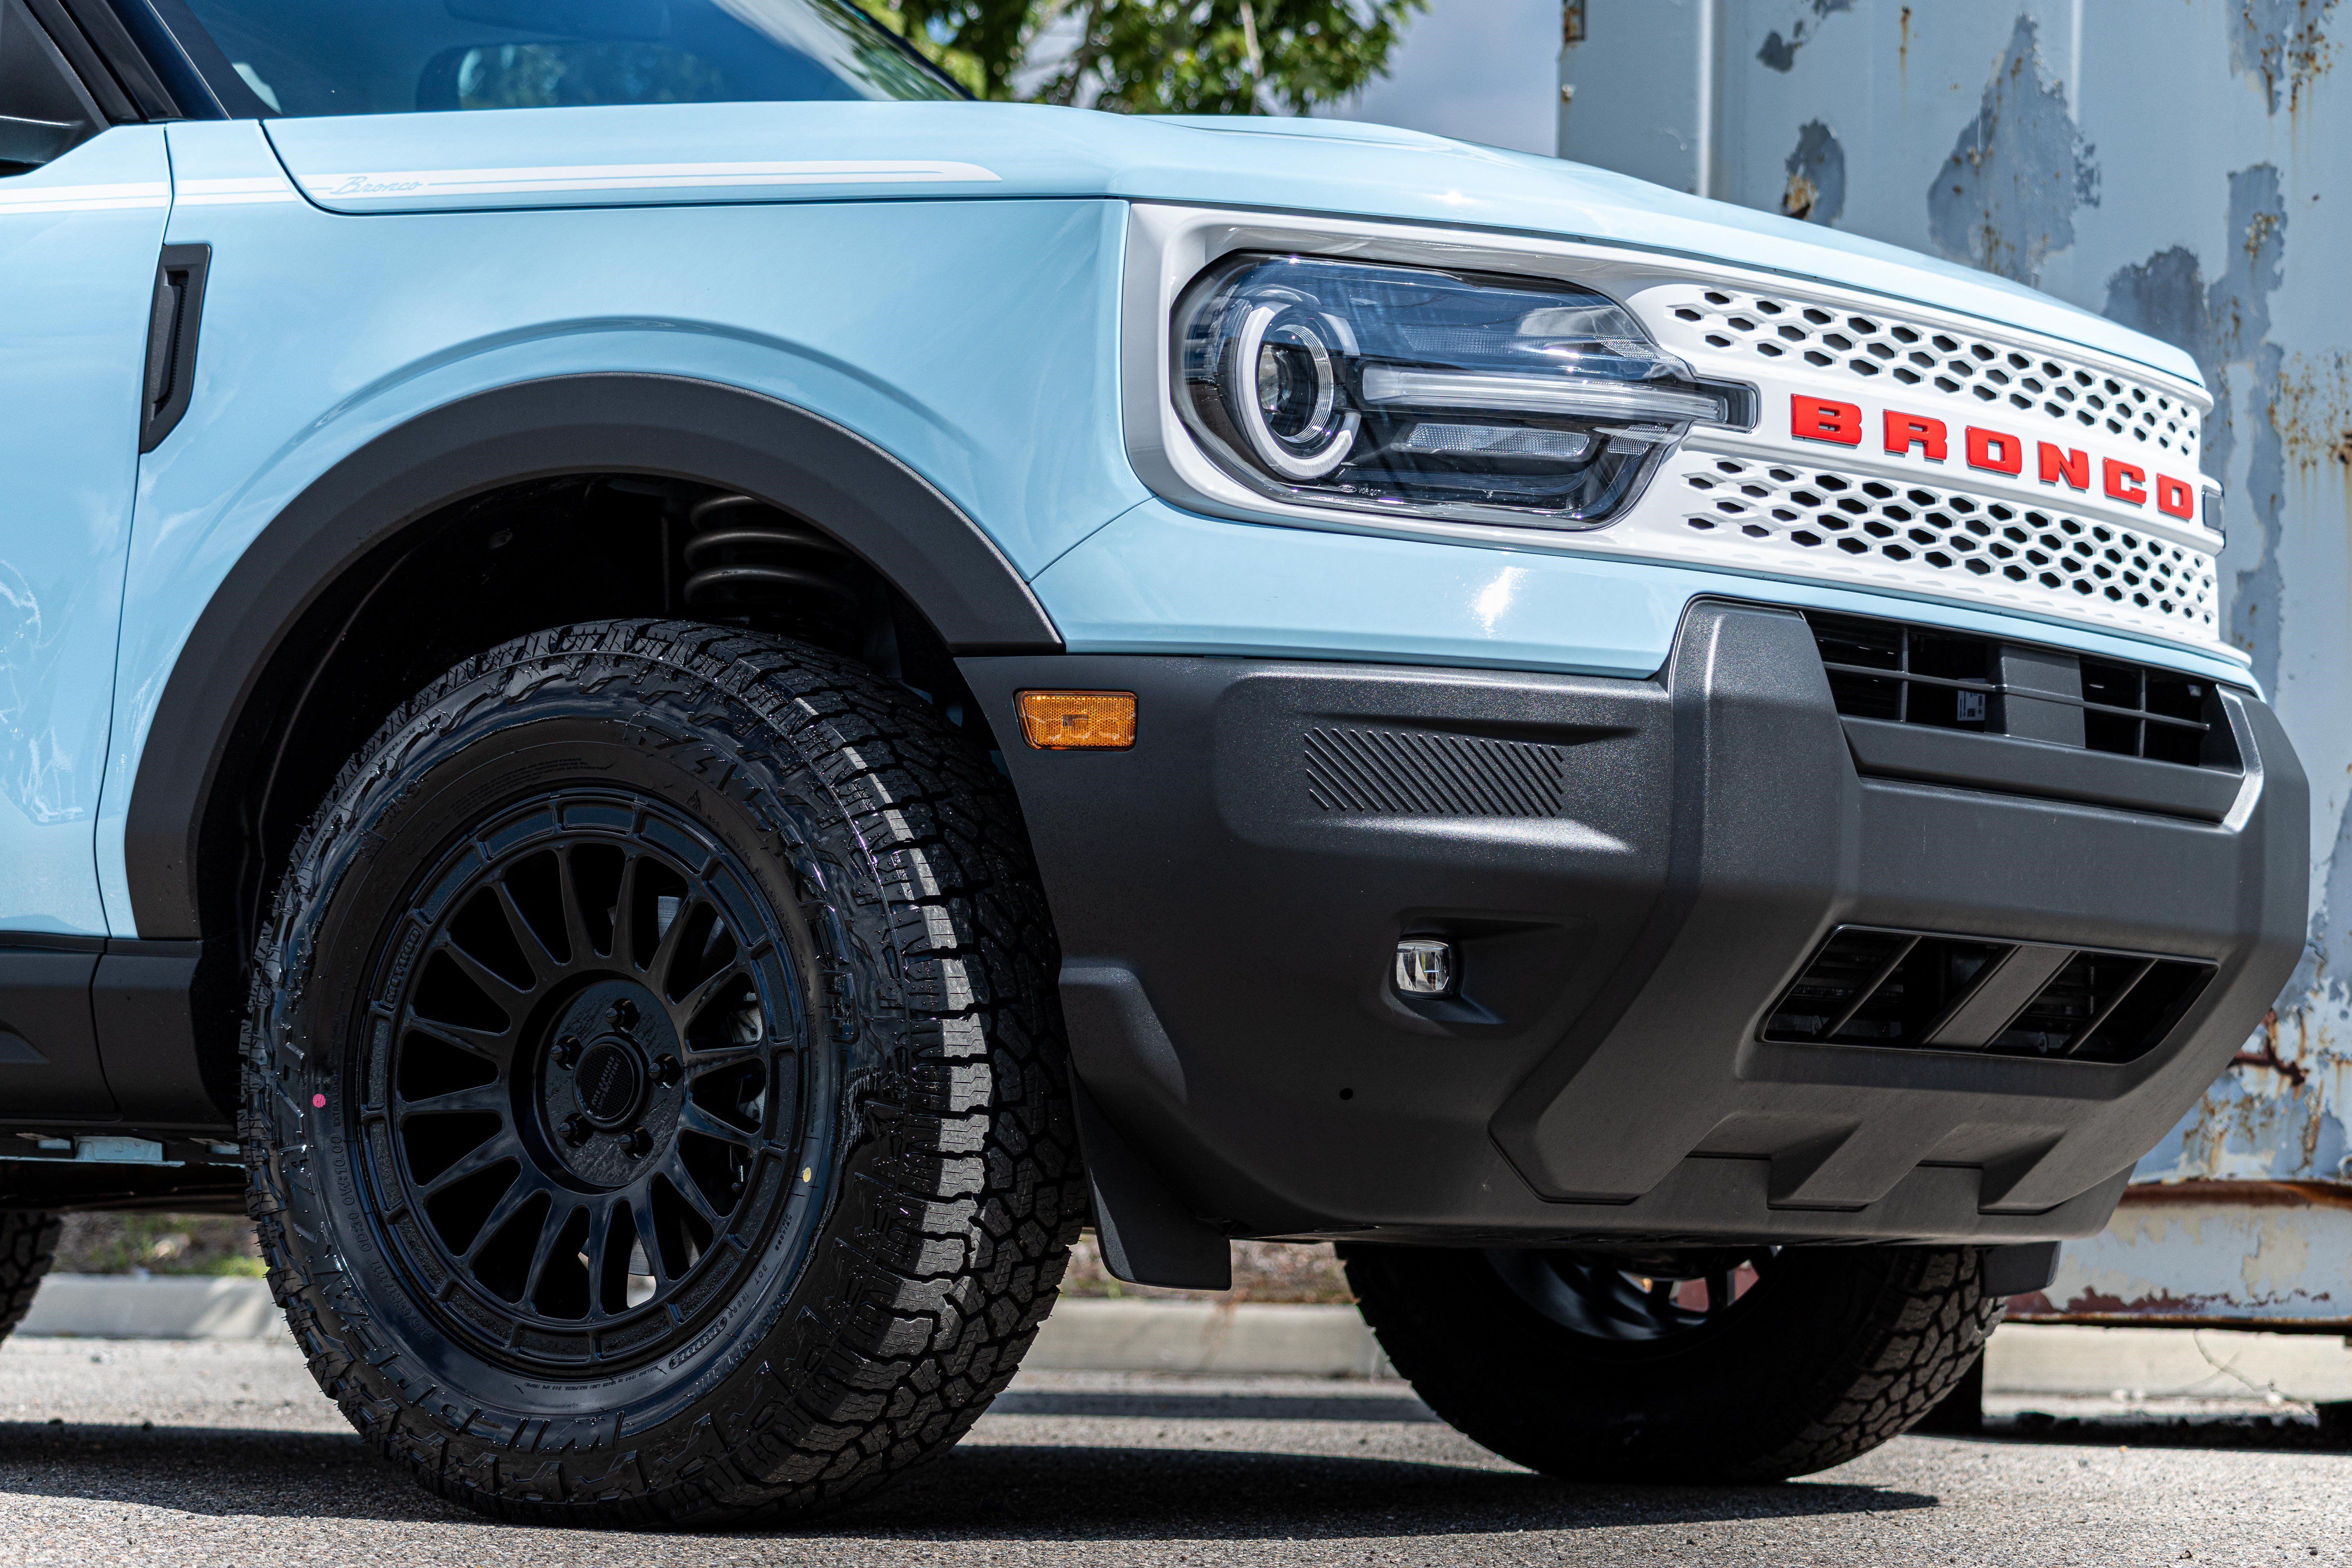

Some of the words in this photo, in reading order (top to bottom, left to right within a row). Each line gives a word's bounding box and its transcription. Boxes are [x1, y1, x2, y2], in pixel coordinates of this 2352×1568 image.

[330, 176, 423, 195] Bronco
[1791, 394, 2194, 520] BRONCO
[378, 726, 416, 764] TEMPERATURE
[343, 776, 366, 805] TRACTION
[614, 708, 860, 1046] FALKEN
[782, 919, 796, 947] RADIAL
[386, 928, 421, 1004] METHOD
[330, 1132, 355, 1209] OW:10.00
[347, 1208, 373, 1256] OD:30
[753, 1263, 768, 1285] DOT
[293, 1221, 624, 1454] WILDPEAK
